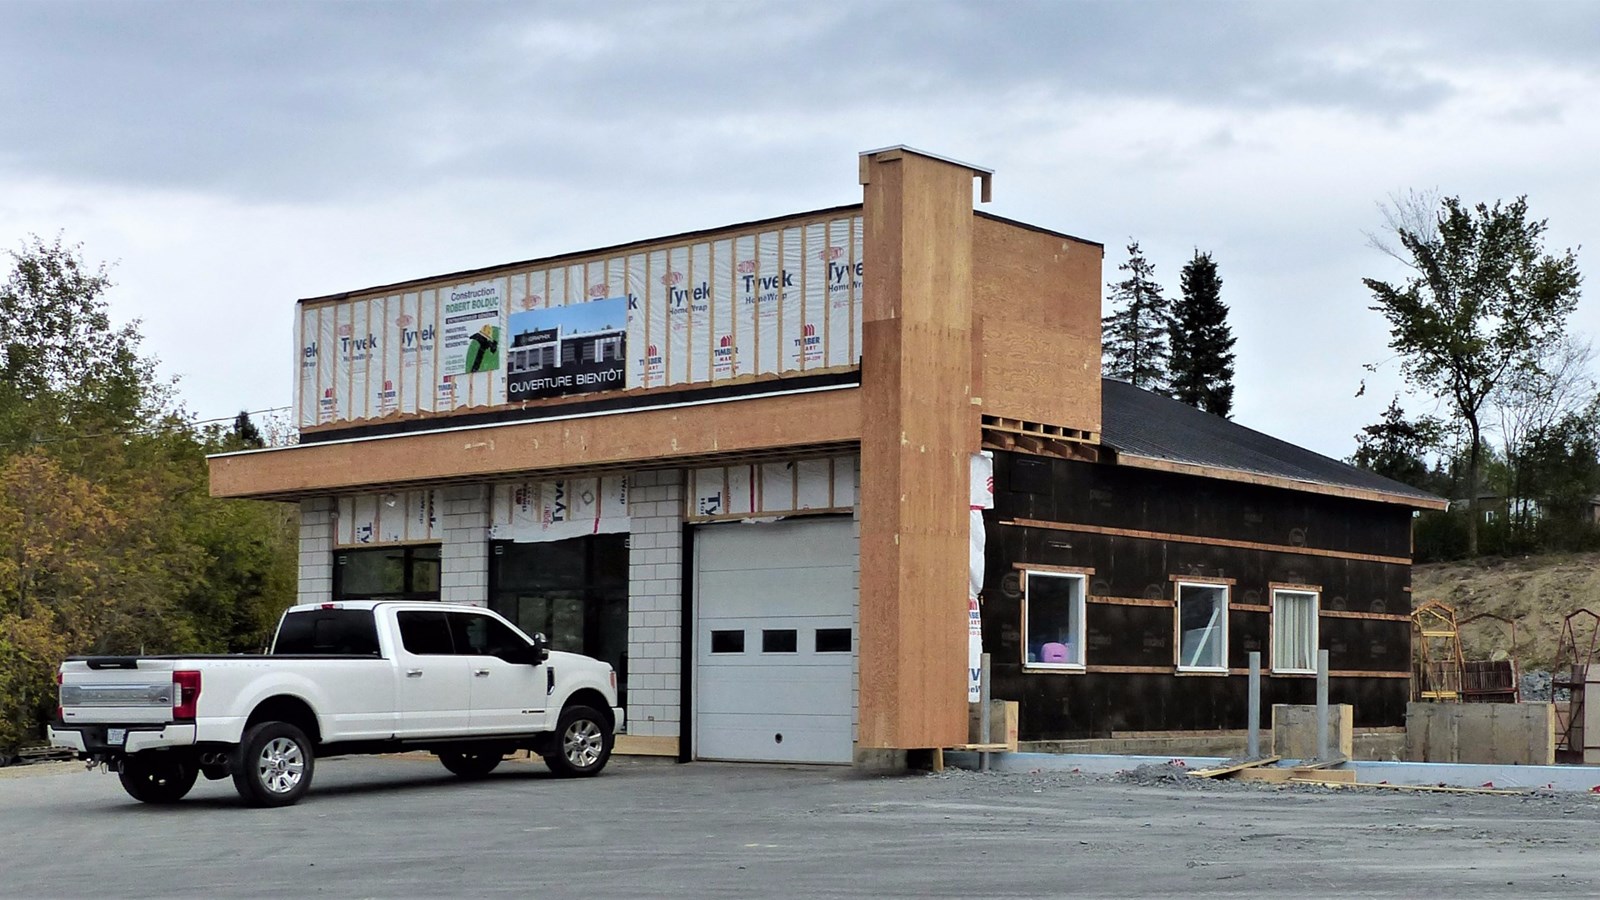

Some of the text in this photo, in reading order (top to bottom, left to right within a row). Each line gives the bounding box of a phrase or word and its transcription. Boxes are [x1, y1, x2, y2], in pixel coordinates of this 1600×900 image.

[451, 287, 496, 301] Construction
[446, 297, 499, 313] ROBERT BOLDUC
[794, 337, 820, 346] TIBER
[714, 346, 739, 356] TIMBR
[639, 356, 662, 366] TIBER
[509, 375, 573, 393] OUVERTURE
[576, 368, 623, 385] BIENTÔT
